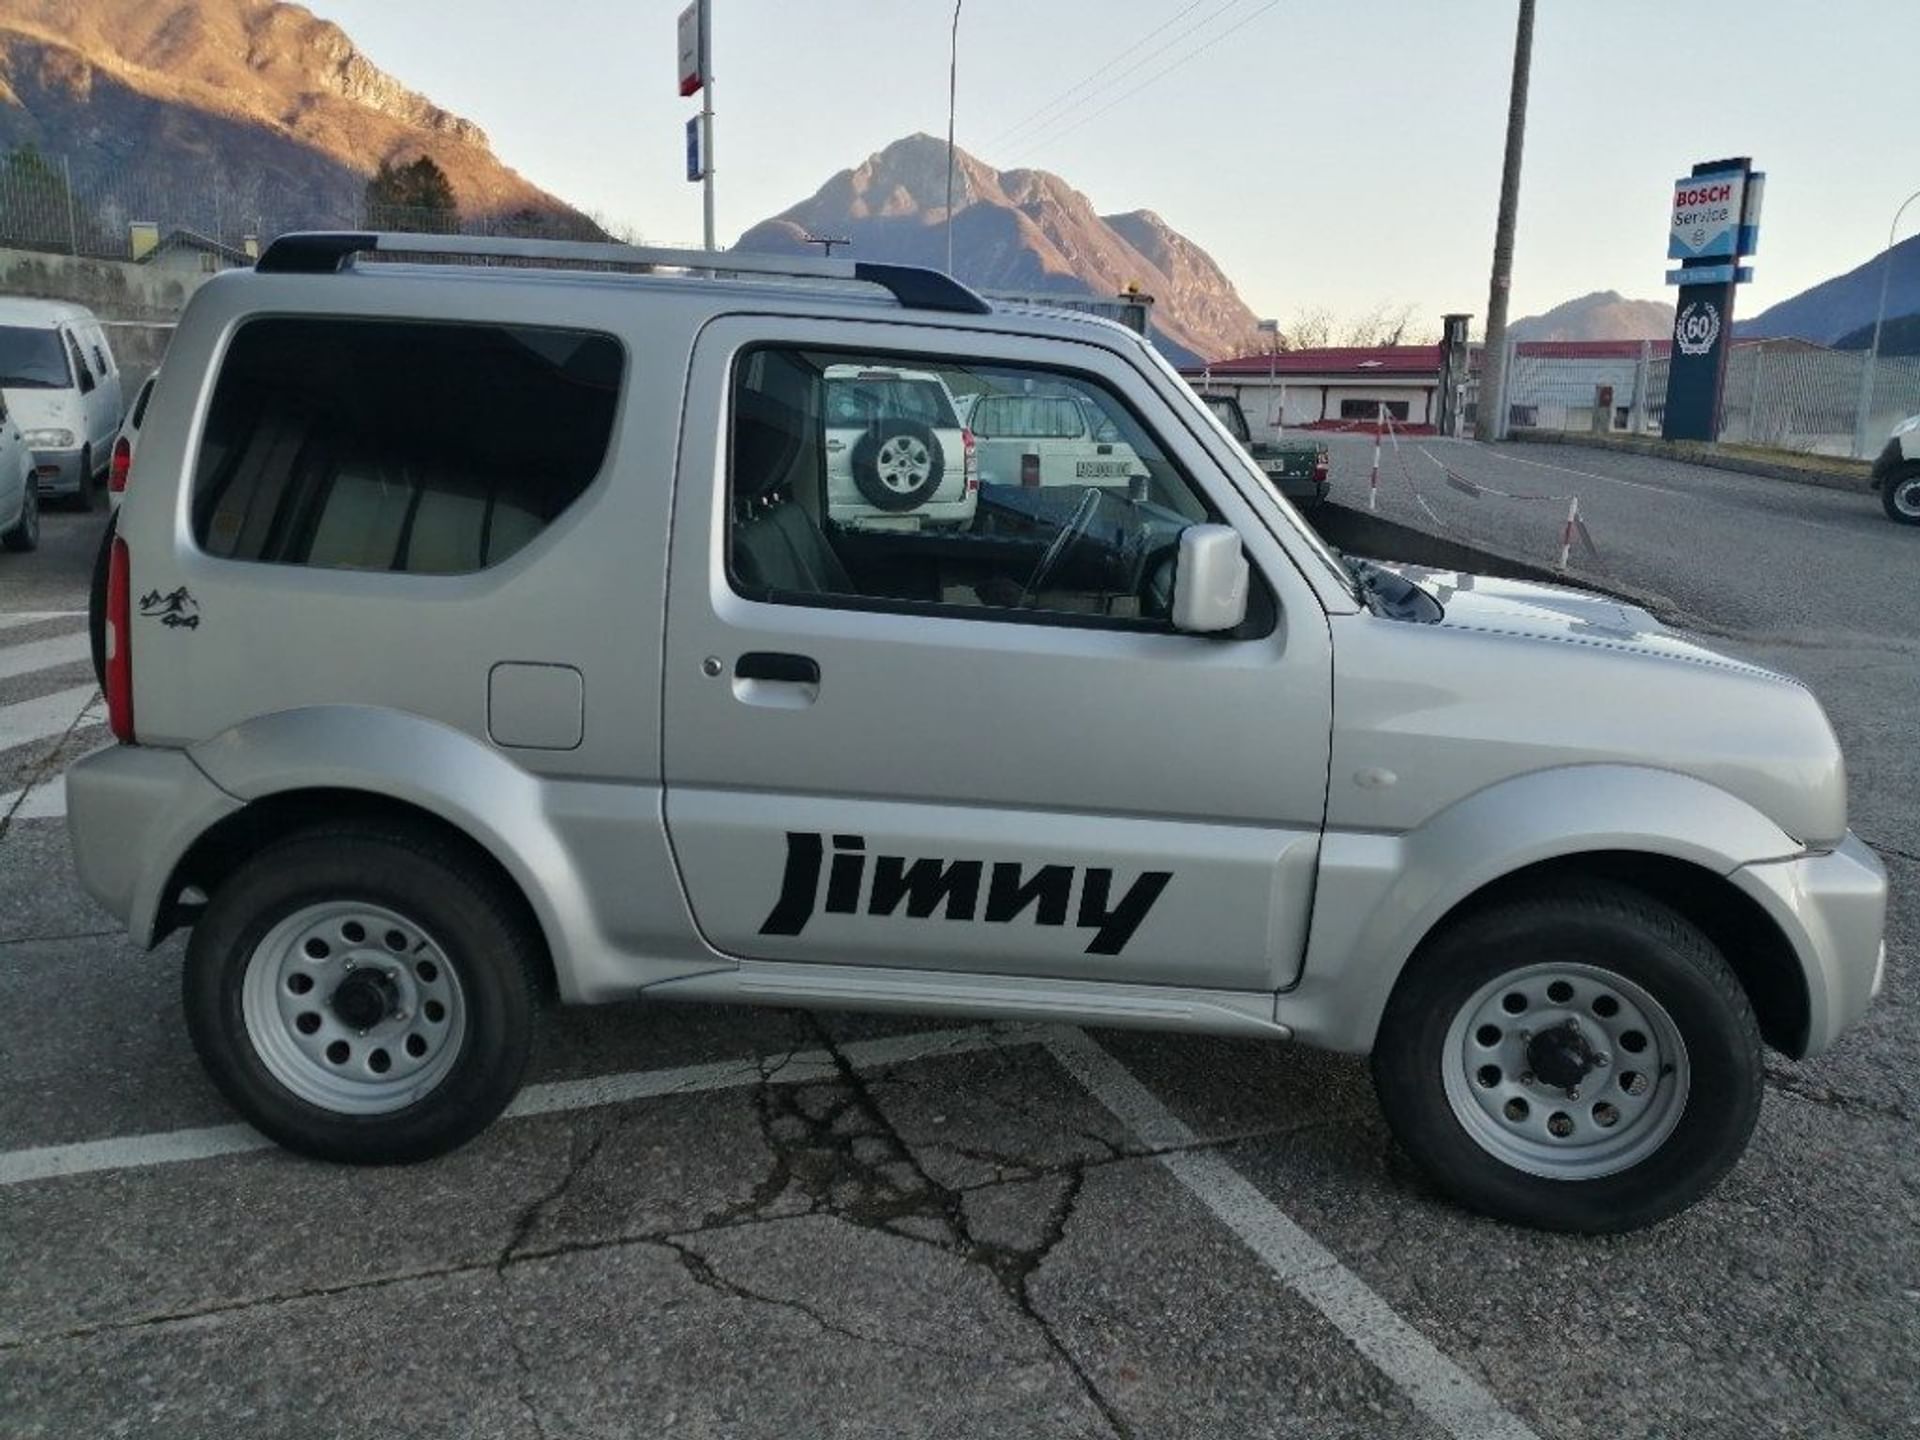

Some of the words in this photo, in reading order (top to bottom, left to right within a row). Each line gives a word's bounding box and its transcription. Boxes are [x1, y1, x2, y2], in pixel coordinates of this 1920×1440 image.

[1676, 184, 1731, 207] BOSCH
[1674, 208, 1728, 226] Service
[1687, 316, 1709, 339] 60
[758, 832, 1174, 955] Jimny
